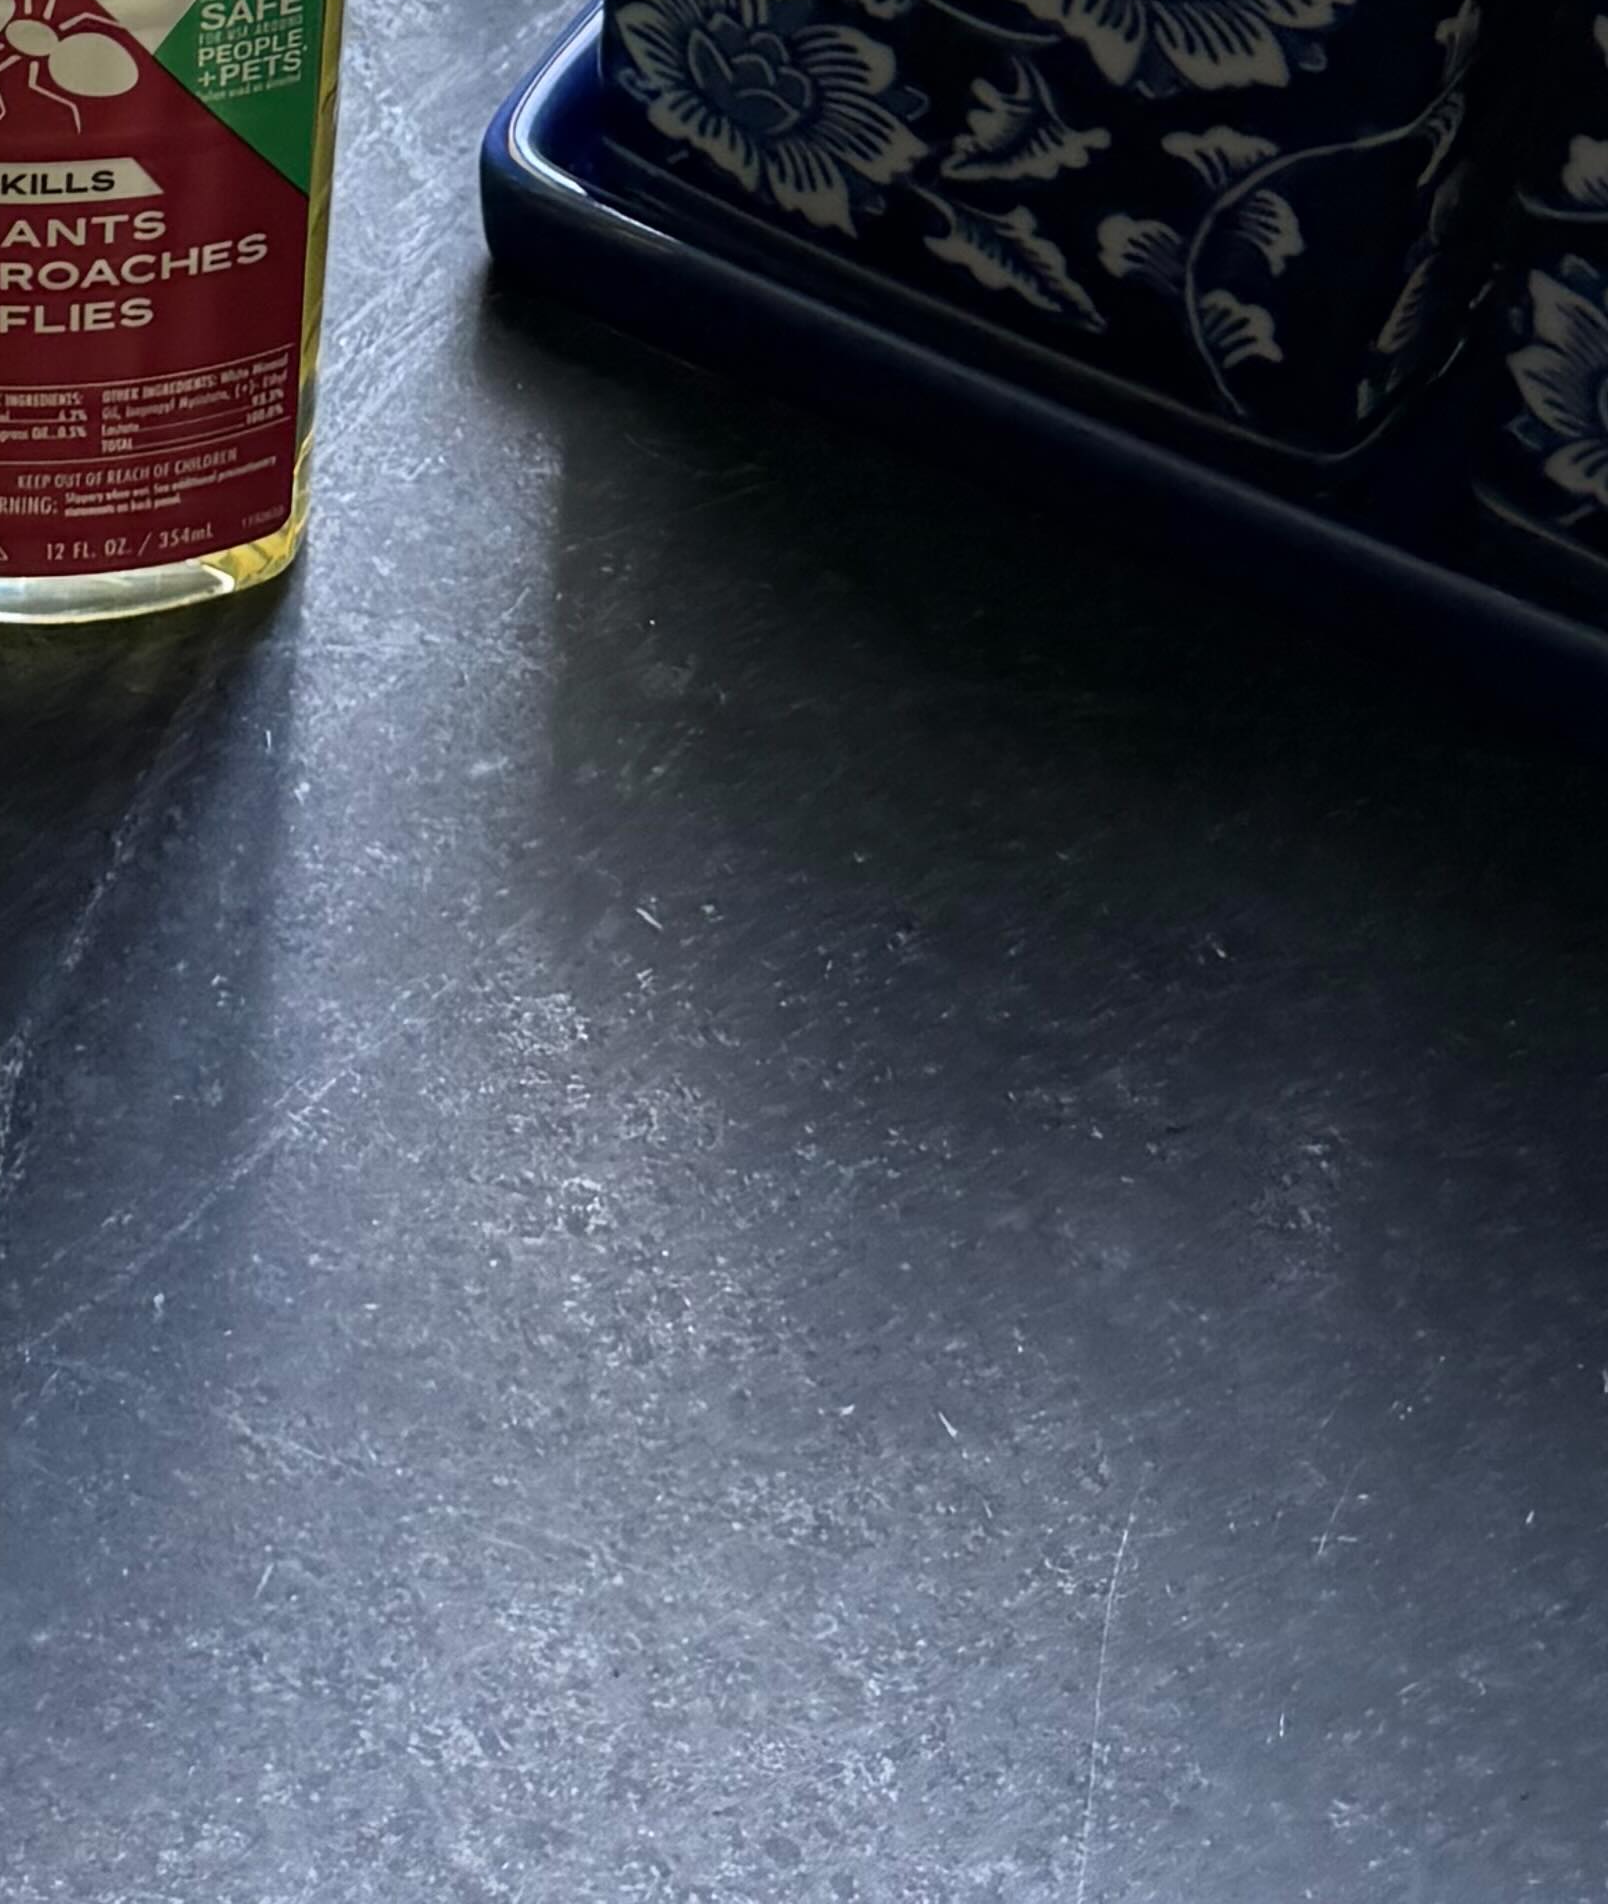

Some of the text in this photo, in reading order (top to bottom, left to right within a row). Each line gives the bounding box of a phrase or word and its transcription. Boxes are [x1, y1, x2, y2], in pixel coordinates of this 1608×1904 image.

[198, 28, 303, 67] PEOPLE
[1, 170, 115, 195] KILLS
[0, 210, 166, 248] ANTS
[0, 233, 268, 291] ROACHES
[18, 474, 51, 489] KEEP
[54, 472, 82, 488] OUT
[86, 470, 102, 486] OF
[107, 466, 150, 484] REACH
[153, 462, 170, 479] OF
[174, 448, 238, 475] CHILDREN
[47, 543, 65, 560] 12
[138, 532, 153, 557] /
[159, 522, 214, 549] 354mL
